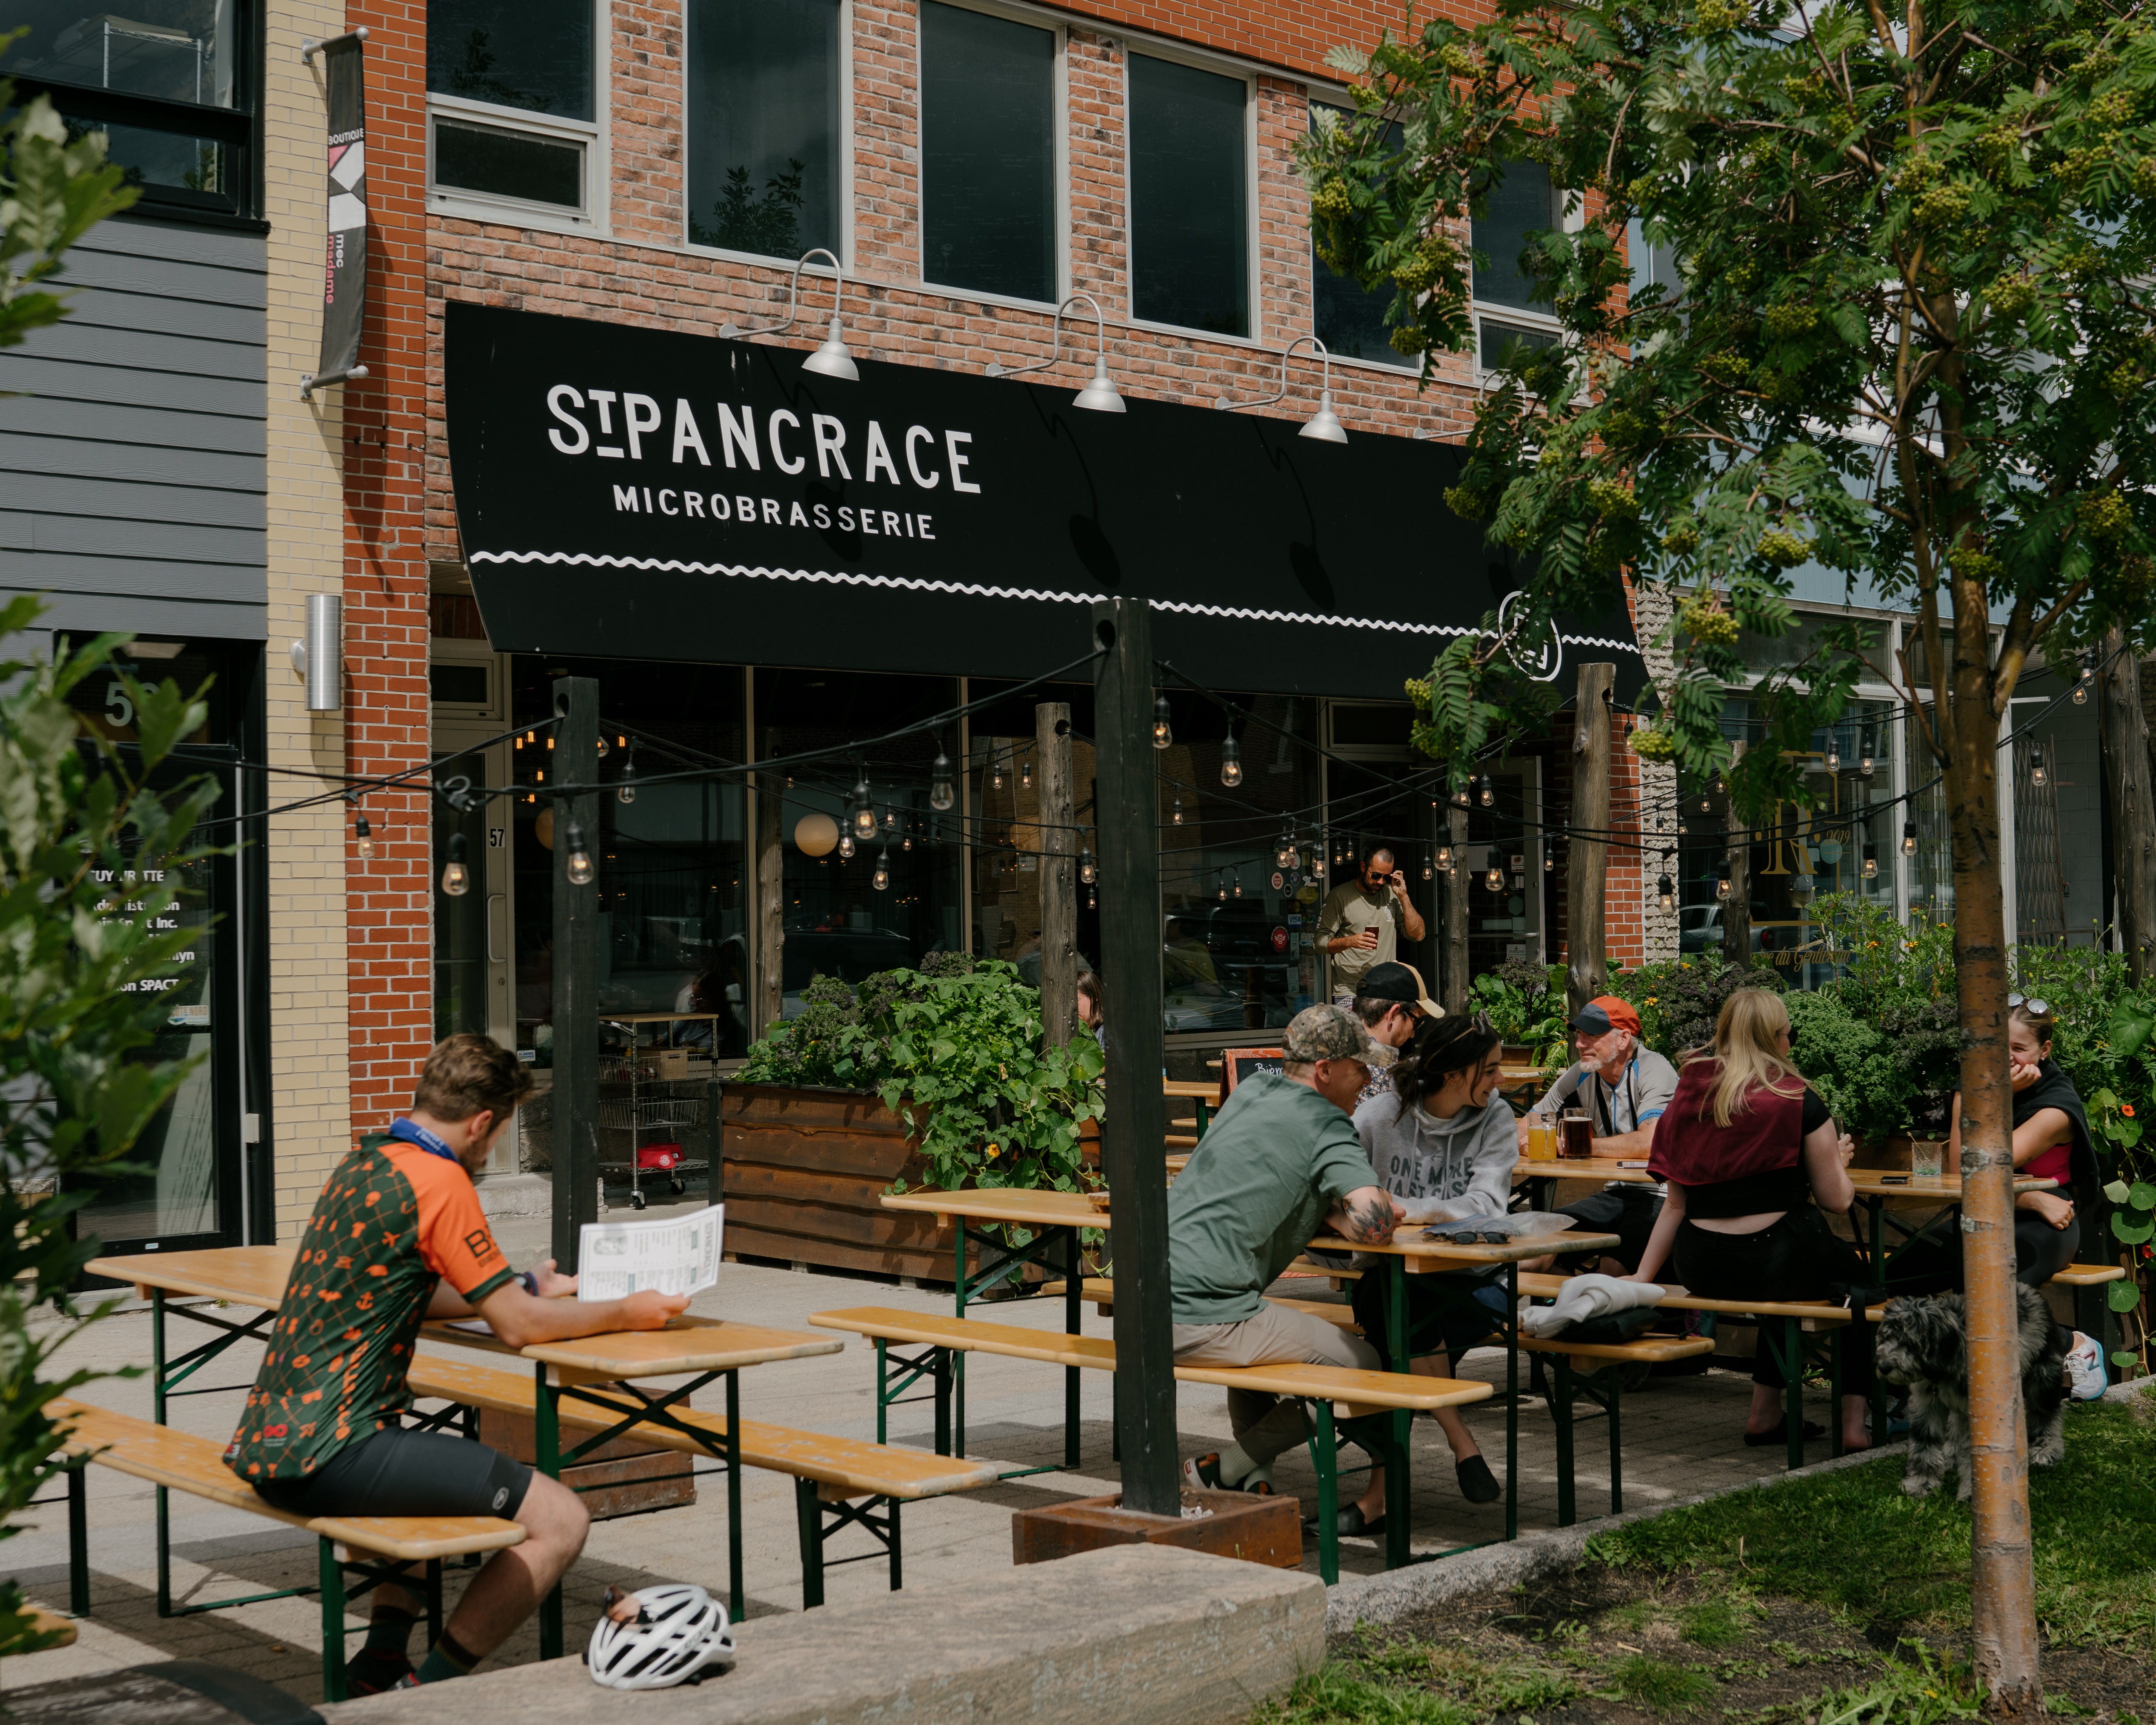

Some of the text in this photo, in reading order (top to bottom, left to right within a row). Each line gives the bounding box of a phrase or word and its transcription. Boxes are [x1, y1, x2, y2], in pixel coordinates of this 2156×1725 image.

[328, 128, 364, 145] BOUTIQUE
[326, 235, 336, 304] madame
[613, 485, 936, 540] MICROBRASSERIE
[490, 828, 504, 847] 57
[90, 870, 114, 881] UY
[156, 917, 178, 928] Inc.
[1776, 945, 1791, 966] du
[1391, 1155, 1422, 1181] ONE
